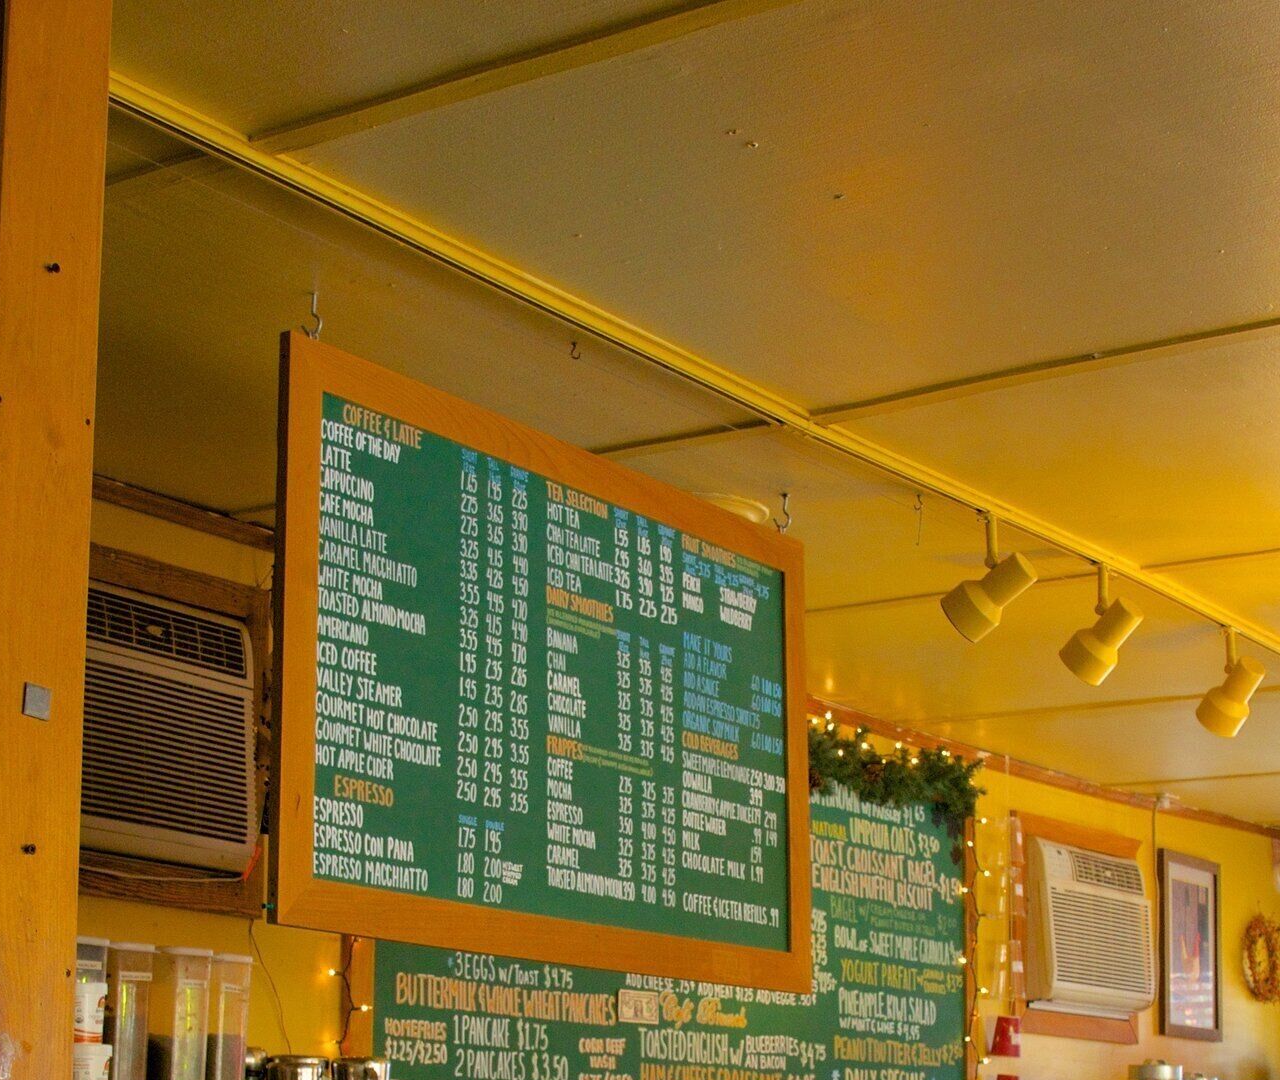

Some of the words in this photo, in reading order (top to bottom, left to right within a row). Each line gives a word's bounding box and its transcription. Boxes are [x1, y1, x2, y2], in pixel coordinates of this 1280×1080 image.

[320, 418, 354, 445] COFFEE
[342, 403, 382, 434] COFFEE
[392, 421, 423, 449] LATTE
[320, 443, 352, 473] LATTE
[320, 465, 375, 503] CAPPUCCINO
[319, 490, 341, 517] CAFE
[342, 496, 374, 527] MOCHA
[319, 516, 358, 546] VANILLA
[359, 528, 388, 555] LATTE
[318, 538, 361, 572] CARAMEL
[318, 564, 350, 593] WHITE
[351, 573, 384, 601] MOCHA
[317, 614, 369, 647] AMERICANO
[316, 641, 339, 665] ICED
[341, 646, 378, 677] COFFEE
[316, 667, 353, 697] VALLEY
[355, 676, 403, 709] STEAMER
[315, 691, 364, 726] GOURMET
[366, 706, 385, 731] HOT
[386, 712, 438, 744] CHOCOLATE
[363, 729, 393, 758] WHITE
[393, 737, 442, 768] CHOCOLATE
[333, 773, 395, 808] ESPRESSO
[313, 795, 364, 829] ESPRESSO
[313, 822, 362, 855] ESPRESSO
[363, 833, 385, 858] CON
[386, 836, 415, 863] PANA
[312, 850, 362, 882] ESPRESSO
[681, 850, 726, 877] CHOCOLATE
[726, 859, 746, 881] MILK
[463, 954, 496, 983] EGGS
[394, 971, 479, 1014] BUTTERMILK
[384, 1016, 448, 1042] HOMEFRIES
[461, 1015, 511, 1050] PANCAKE
[516, 1018, 549, 1052] $1.75
[744, 1034, 800, 1057] BLUEBERRIES
[454, 1048, 466, 1079] 2
